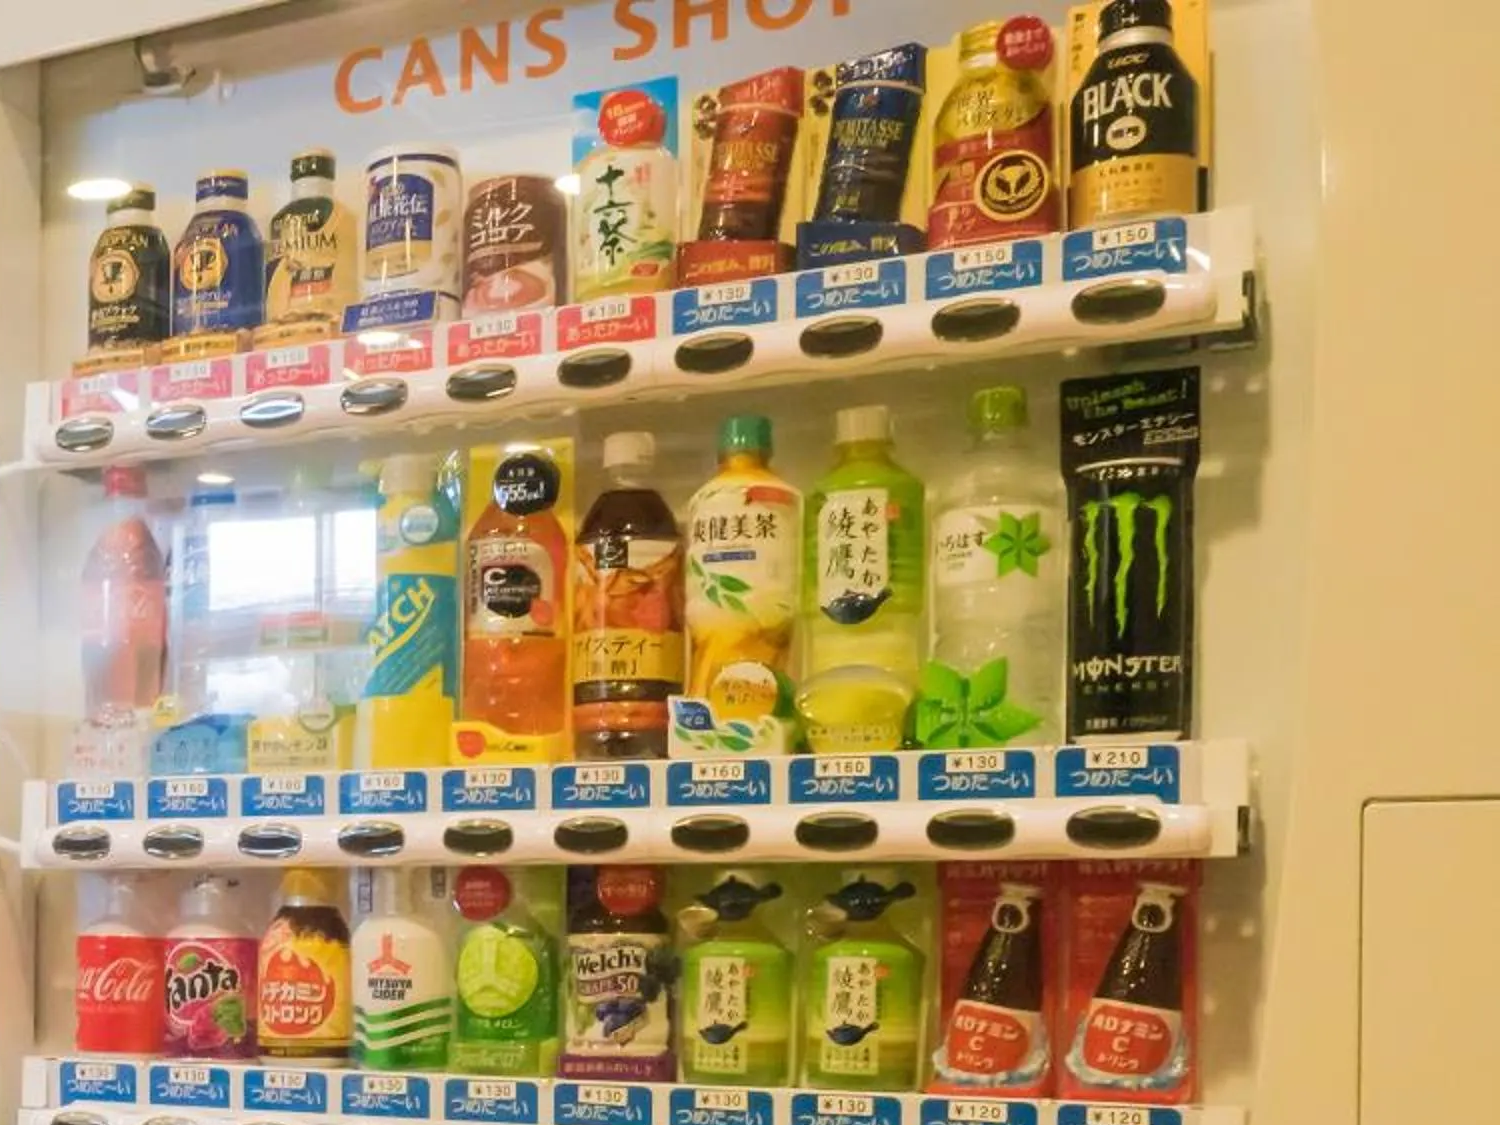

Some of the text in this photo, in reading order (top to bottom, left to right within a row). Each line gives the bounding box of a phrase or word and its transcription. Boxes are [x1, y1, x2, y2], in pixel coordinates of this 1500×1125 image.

[334, 8, 568, 114] CANS
[1083, 73, 1173, 123] BLACK
[471, 202, 534, 228] ミルク
[593, 164, 637, 266] 十六茶
[470, 223, 535, 248] ココア
[860, 497, 882, 589] あやたか
[364, 576, 436, 648] ATCH
[1073, 653, 1184, 682] MONSTER
[953, 756, 998, 769] ¥130
[1092, 751, 1141, 765] ¥210
[576, 948, 643, 976] Welch's
[617, 974, 639, 994] 50
[968, 1037, 985, 1052] C
[1112, 1036, 1130, 1053] C
